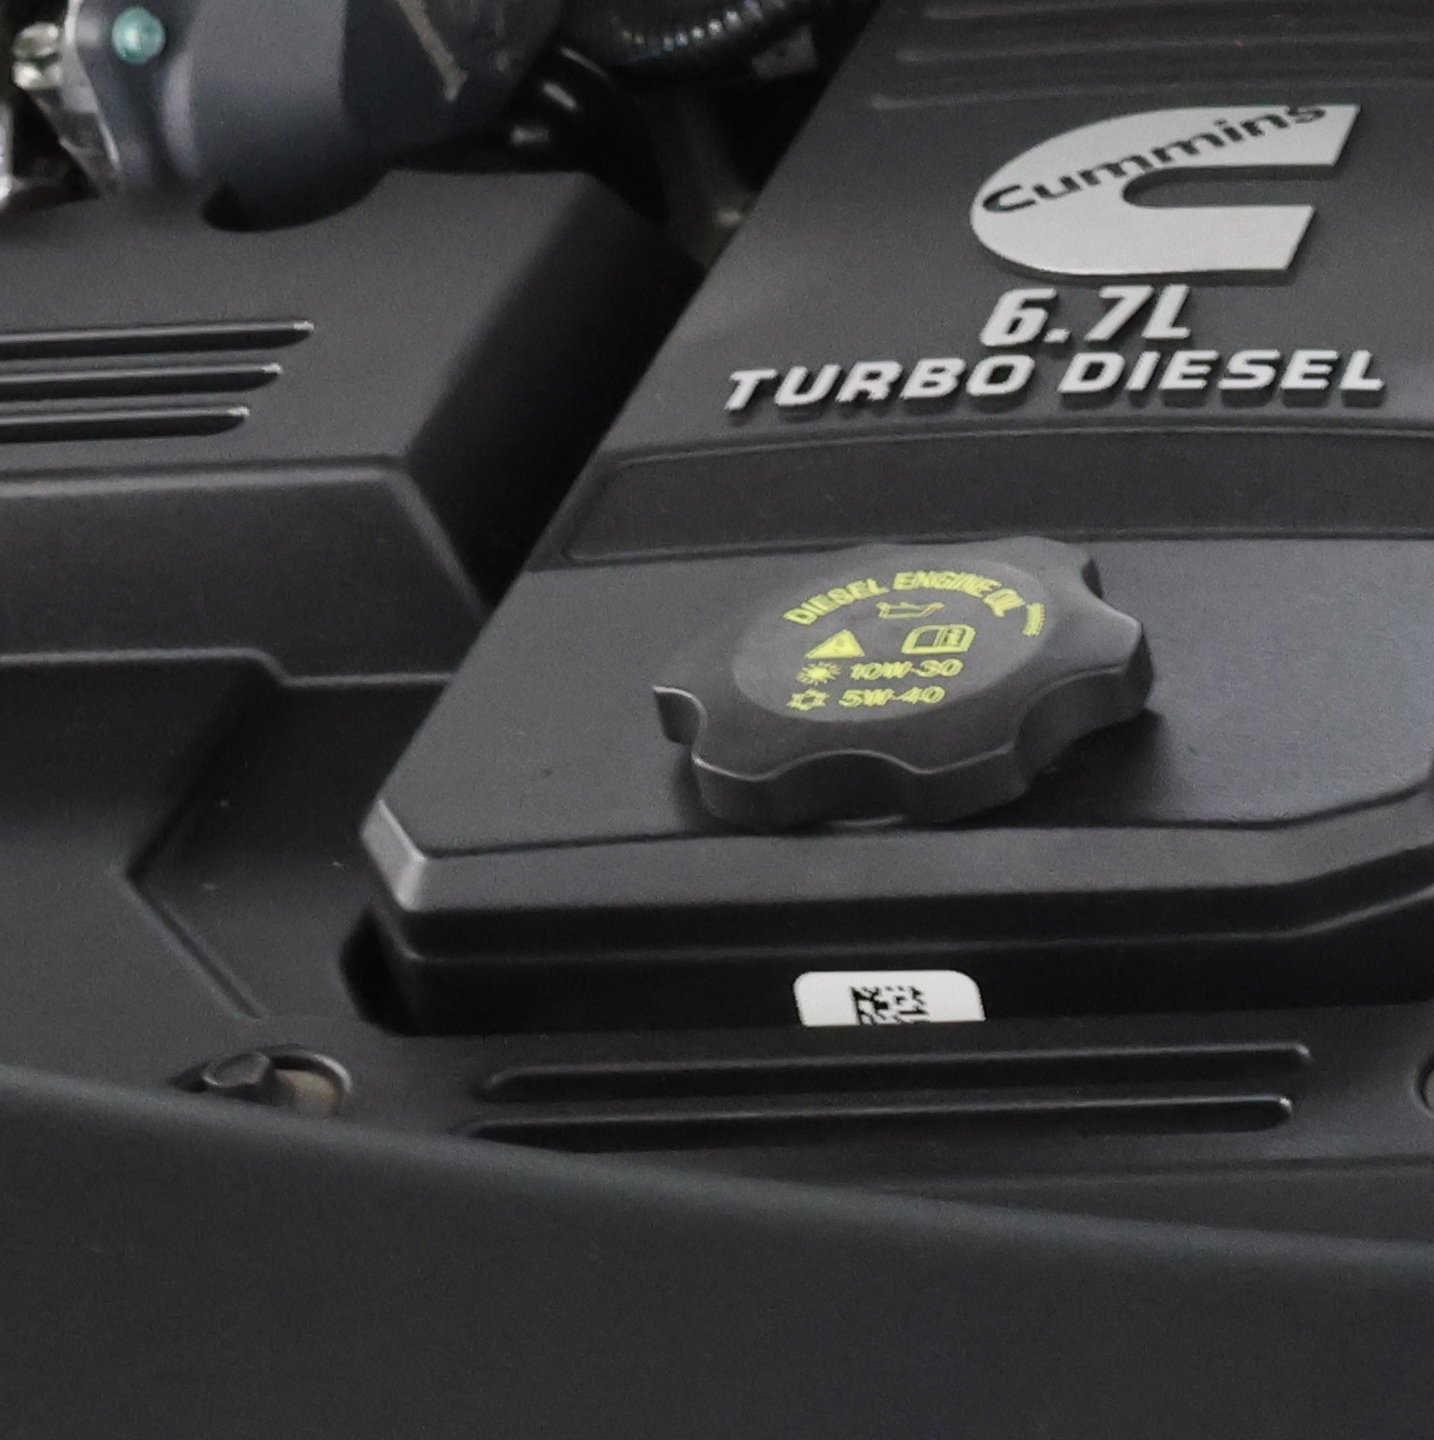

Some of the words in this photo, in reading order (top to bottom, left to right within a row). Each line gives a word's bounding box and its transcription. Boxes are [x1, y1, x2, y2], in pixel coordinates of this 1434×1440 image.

[981, 103, 1327, 214] Cummins
[979, 285, 1192, 348] 6.7L
[724, 354, 1037, 411] TURBO
[1057, 349, 1387, 393] DIESEL
[783, 577, 891, 625] DIESEL
[892, 570, 1003, 599] ENGINE
[838, 685, 946, 707] 5W-40
[850, 657, 964, 681] 10W-30
